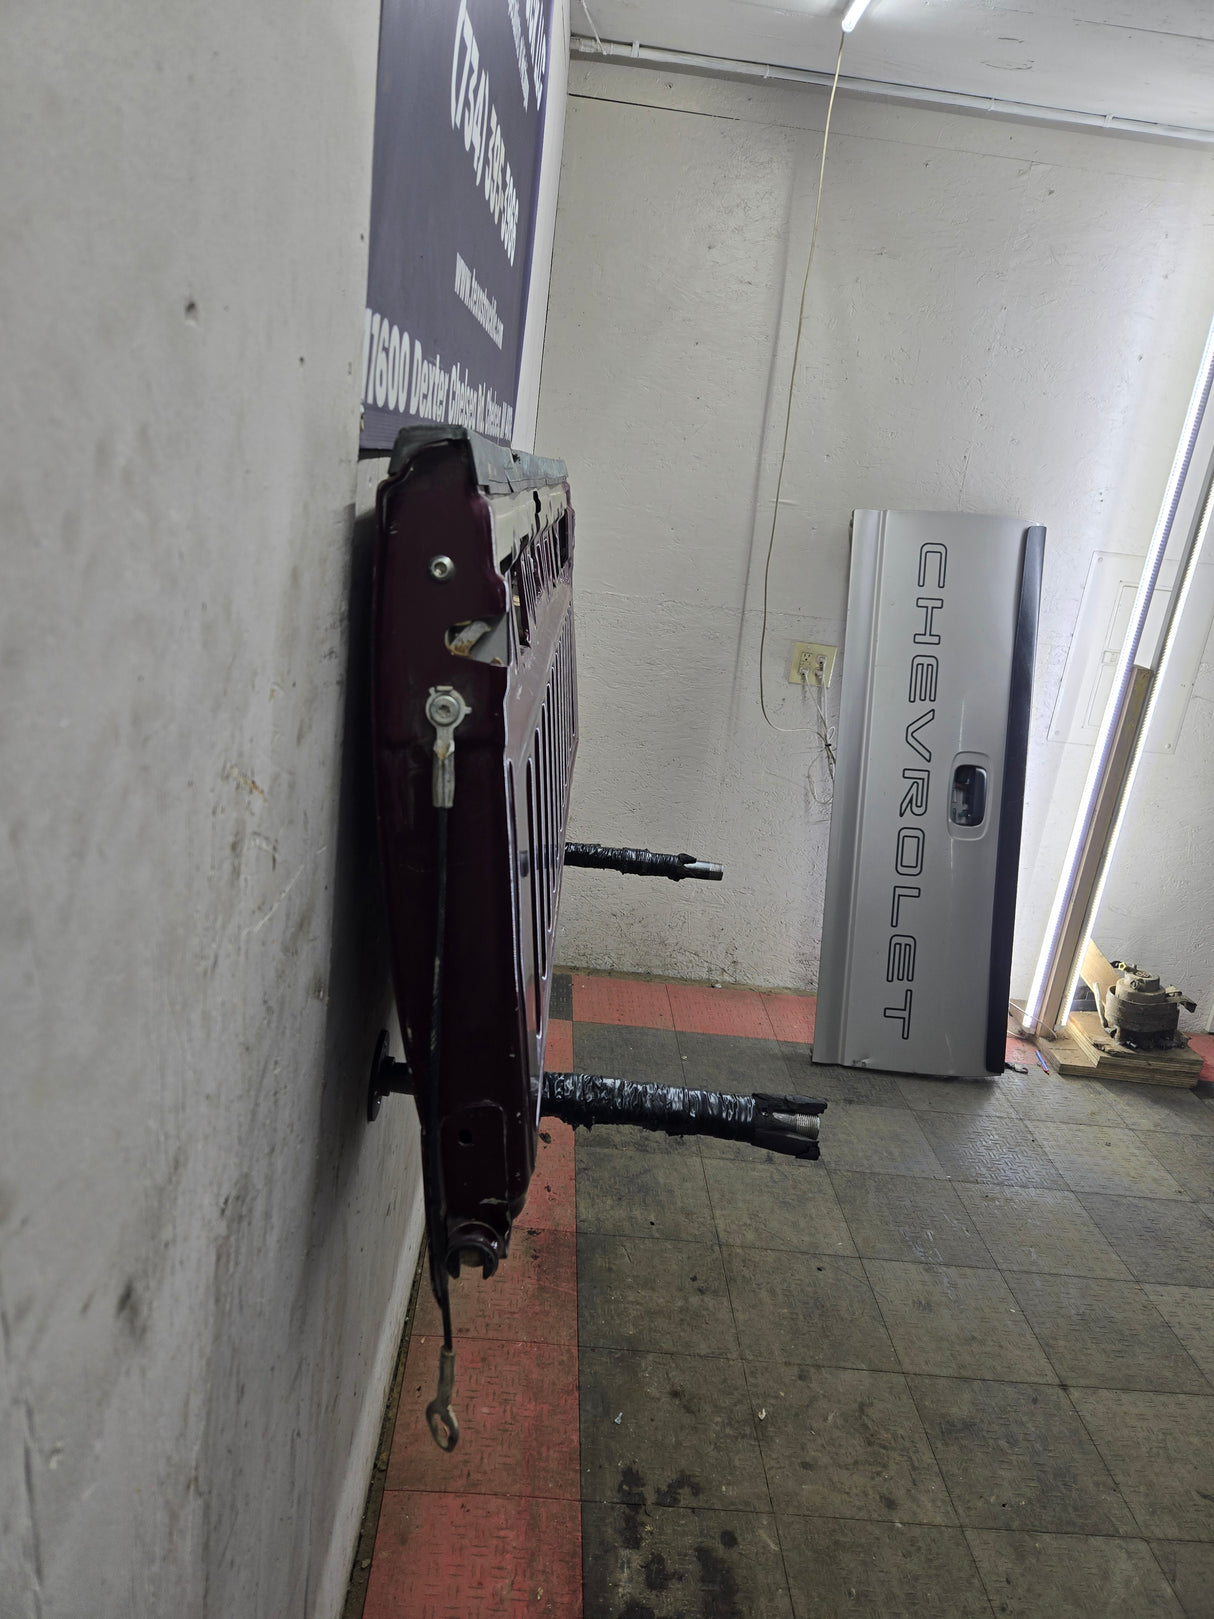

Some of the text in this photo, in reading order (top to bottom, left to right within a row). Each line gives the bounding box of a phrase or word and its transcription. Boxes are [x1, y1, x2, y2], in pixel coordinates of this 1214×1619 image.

[450, 0, 489, 187] (734)
[409, 339, 450, 423] Dexter
[448, 362, 477, 431] Chelsea
[884, 542, 947, 1040] CHEVROLET
